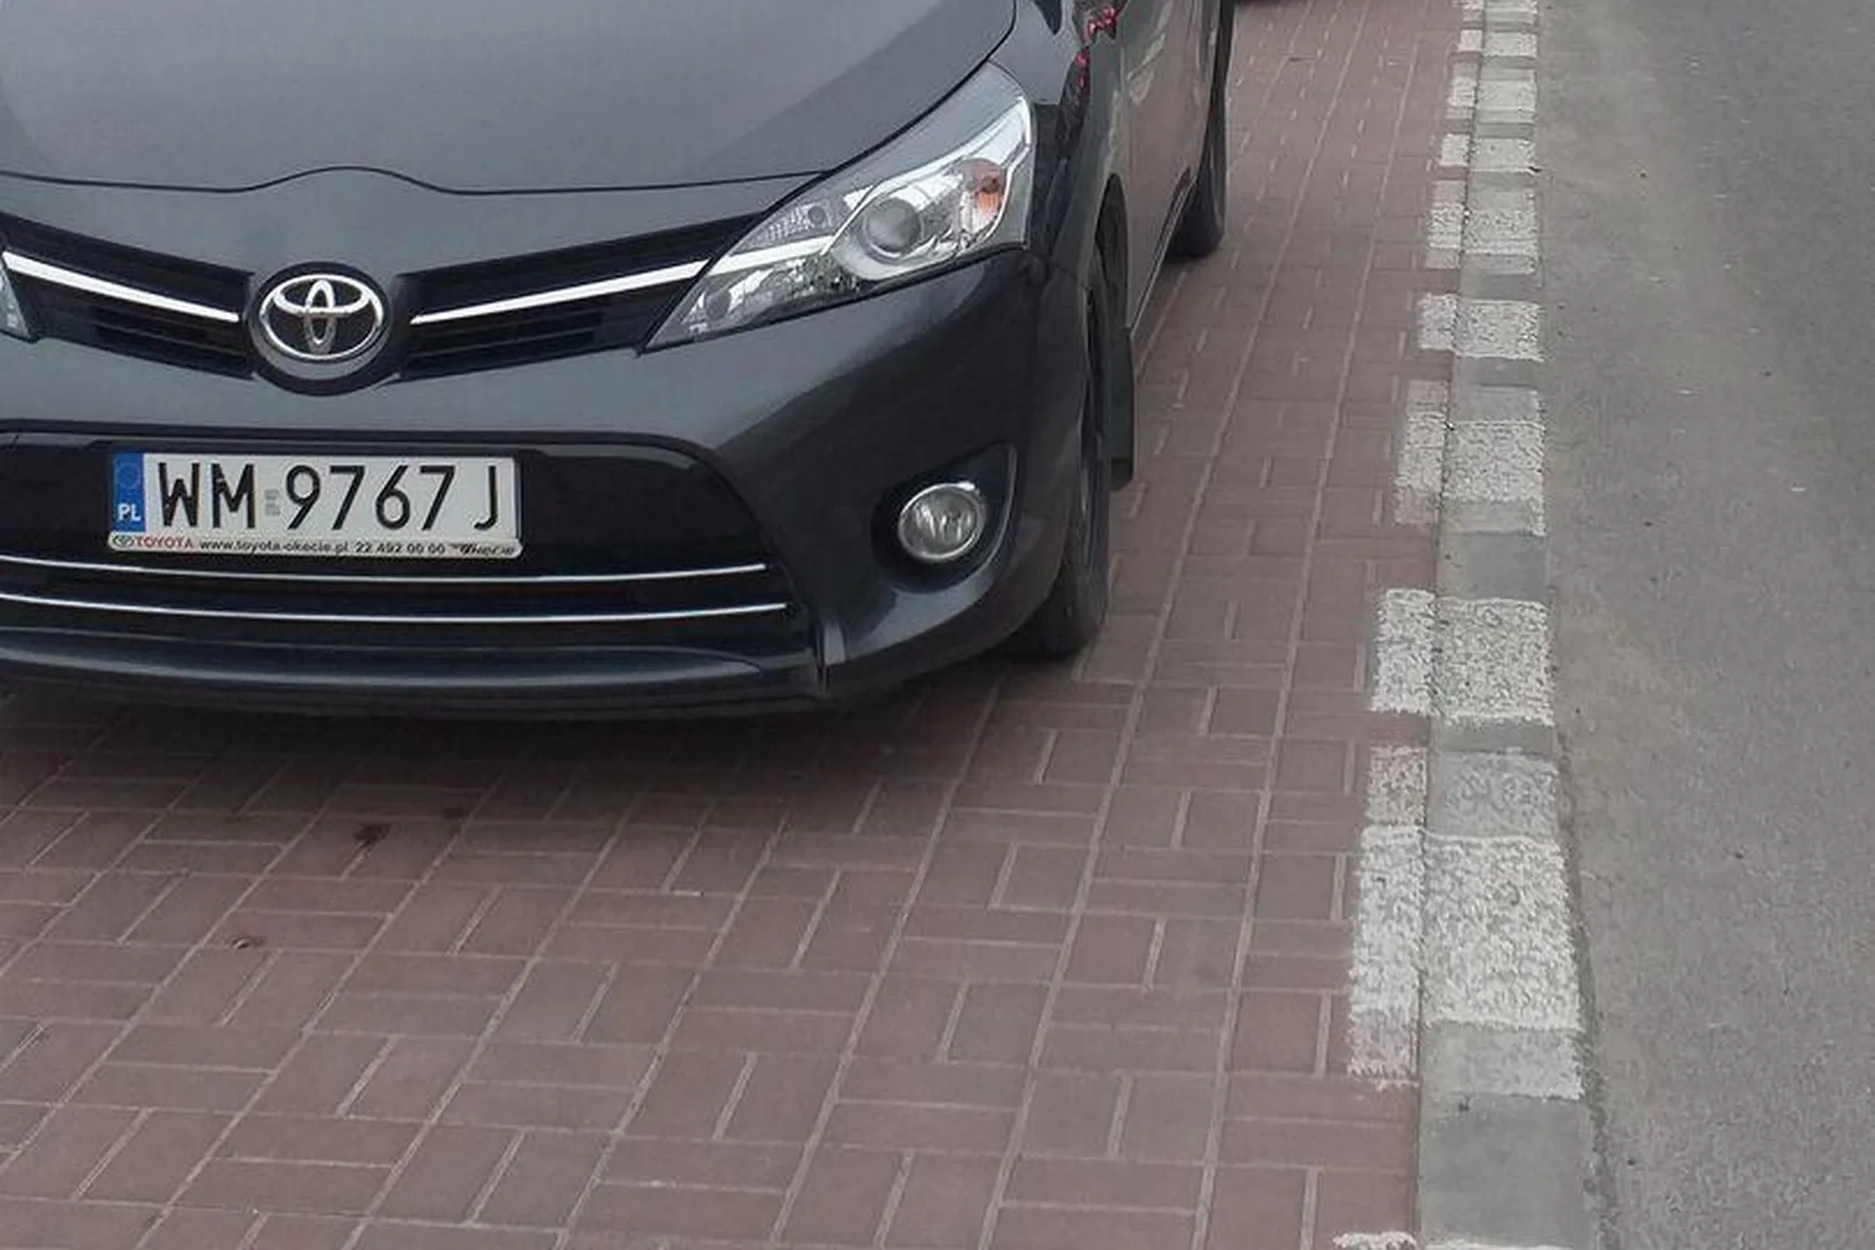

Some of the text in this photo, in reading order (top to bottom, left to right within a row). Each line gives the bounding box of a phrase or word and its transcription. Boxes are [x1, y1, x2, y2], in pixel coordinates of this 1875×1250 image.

[157, 462, 500, 531] WM 9767J
[117, 504, 142, 523] PL
[134, 534, 195, 549] TOYOTA
